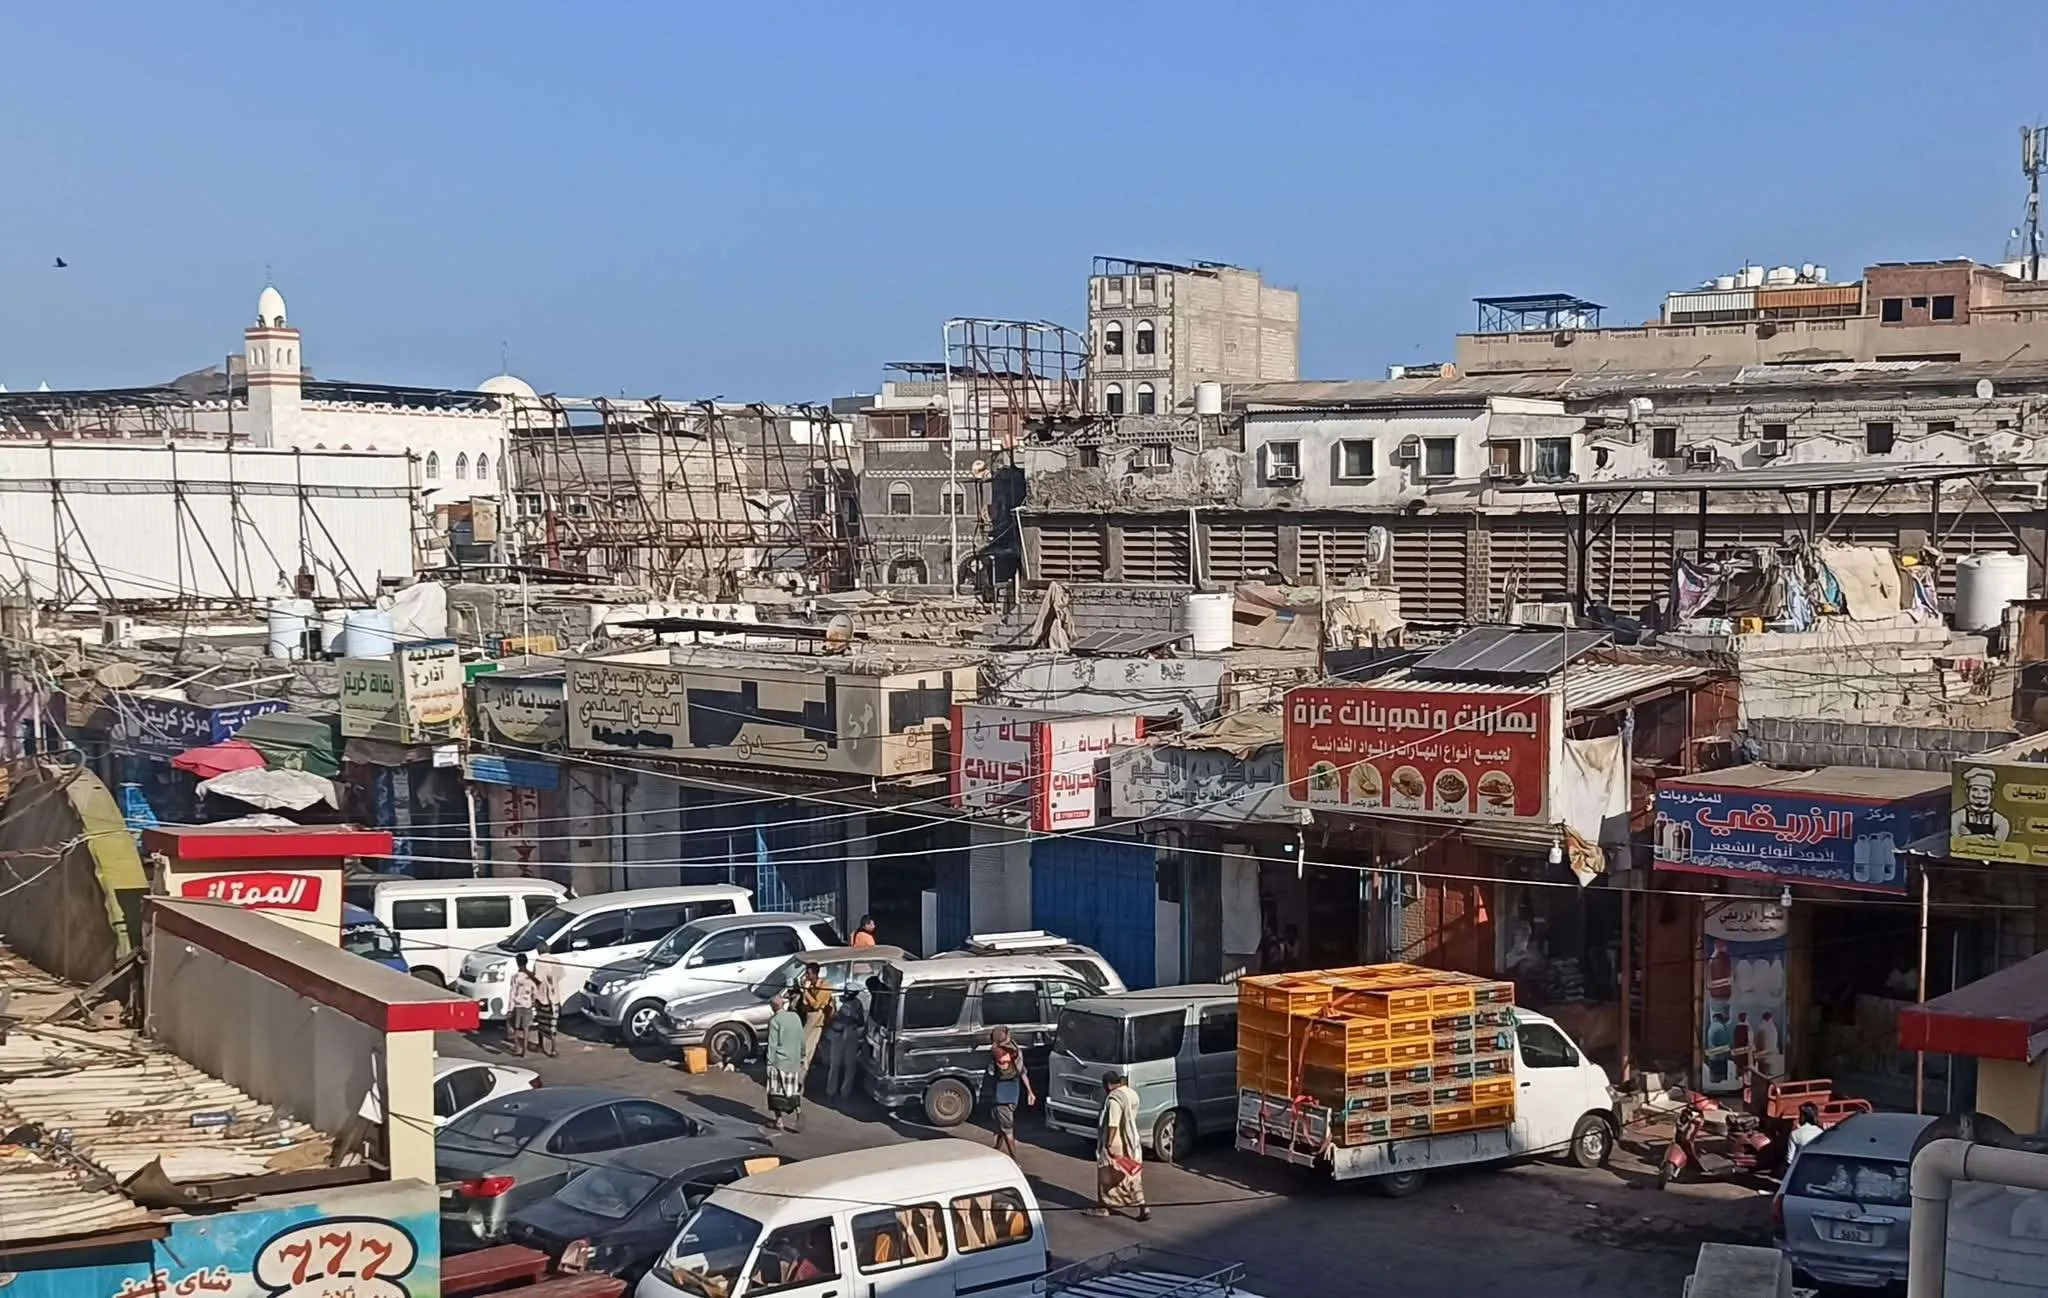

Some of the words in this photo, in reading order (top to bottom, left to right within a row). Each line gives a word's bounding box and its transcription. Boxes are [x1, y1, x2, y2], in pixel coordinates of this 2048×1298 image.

[407, 647, 455, 667] صيدلية
[343, 671, 367, 696] كريتر
[369, 672, 394, 700] بقالة
[518, 690, 560, 715] صيدلية
[579, 698, 629, 729] البلدي
[630, 701, 681, 729] الدجاج
[1293, 697, 1333, 729] غزة
[180, 708, 211, 738] مركز
[1454, 702, 1538, 740] بهارات
[736, 734, 828, 761] عدن
[1311, 735, 1357, 753] الغذائية
[1399, 744, 1443, 761] البهارات
[1443, 742, 1472, 764] أنواع
[1471, 746, 1511, 766] لجميع
[1658, 788, 1723, 804] للمشروبات
[1696, 803, 1854, 844] الزريقي
[1866, 807, 1896, 822] مركز
[1760, 843, 1793, 858] أنواع
[278, 1231, 393, 1286] 777
